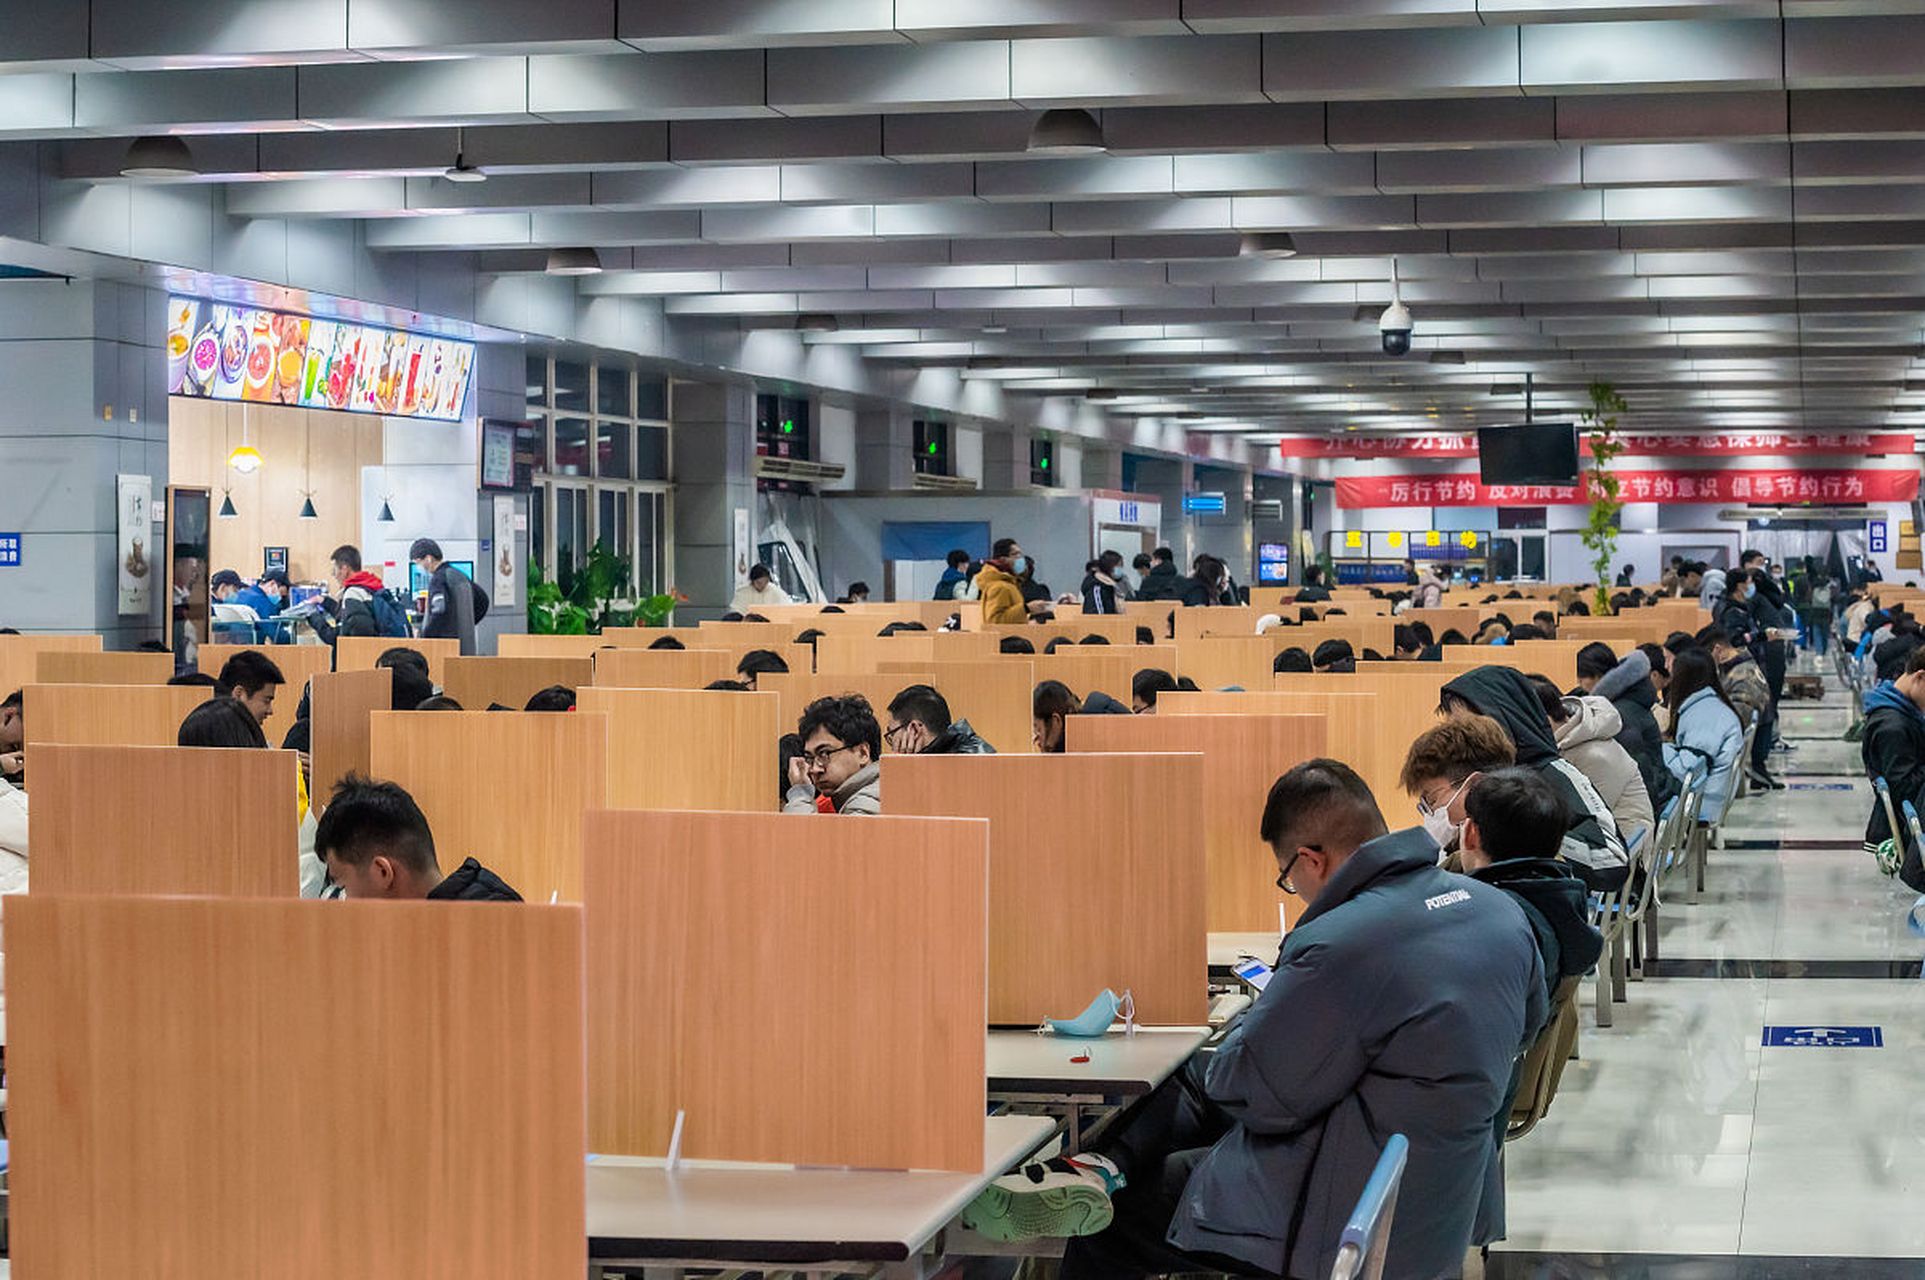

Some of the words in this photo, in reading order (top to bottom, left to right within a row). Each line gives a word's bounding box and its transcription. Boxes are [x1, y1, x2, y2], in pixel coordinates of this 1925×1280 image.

[1391, 480, 1476, 502] 厉行节约
[1731, 476, 1864, 498] 倡导节约行为
[1872, 524, 1884, 550] 出口
